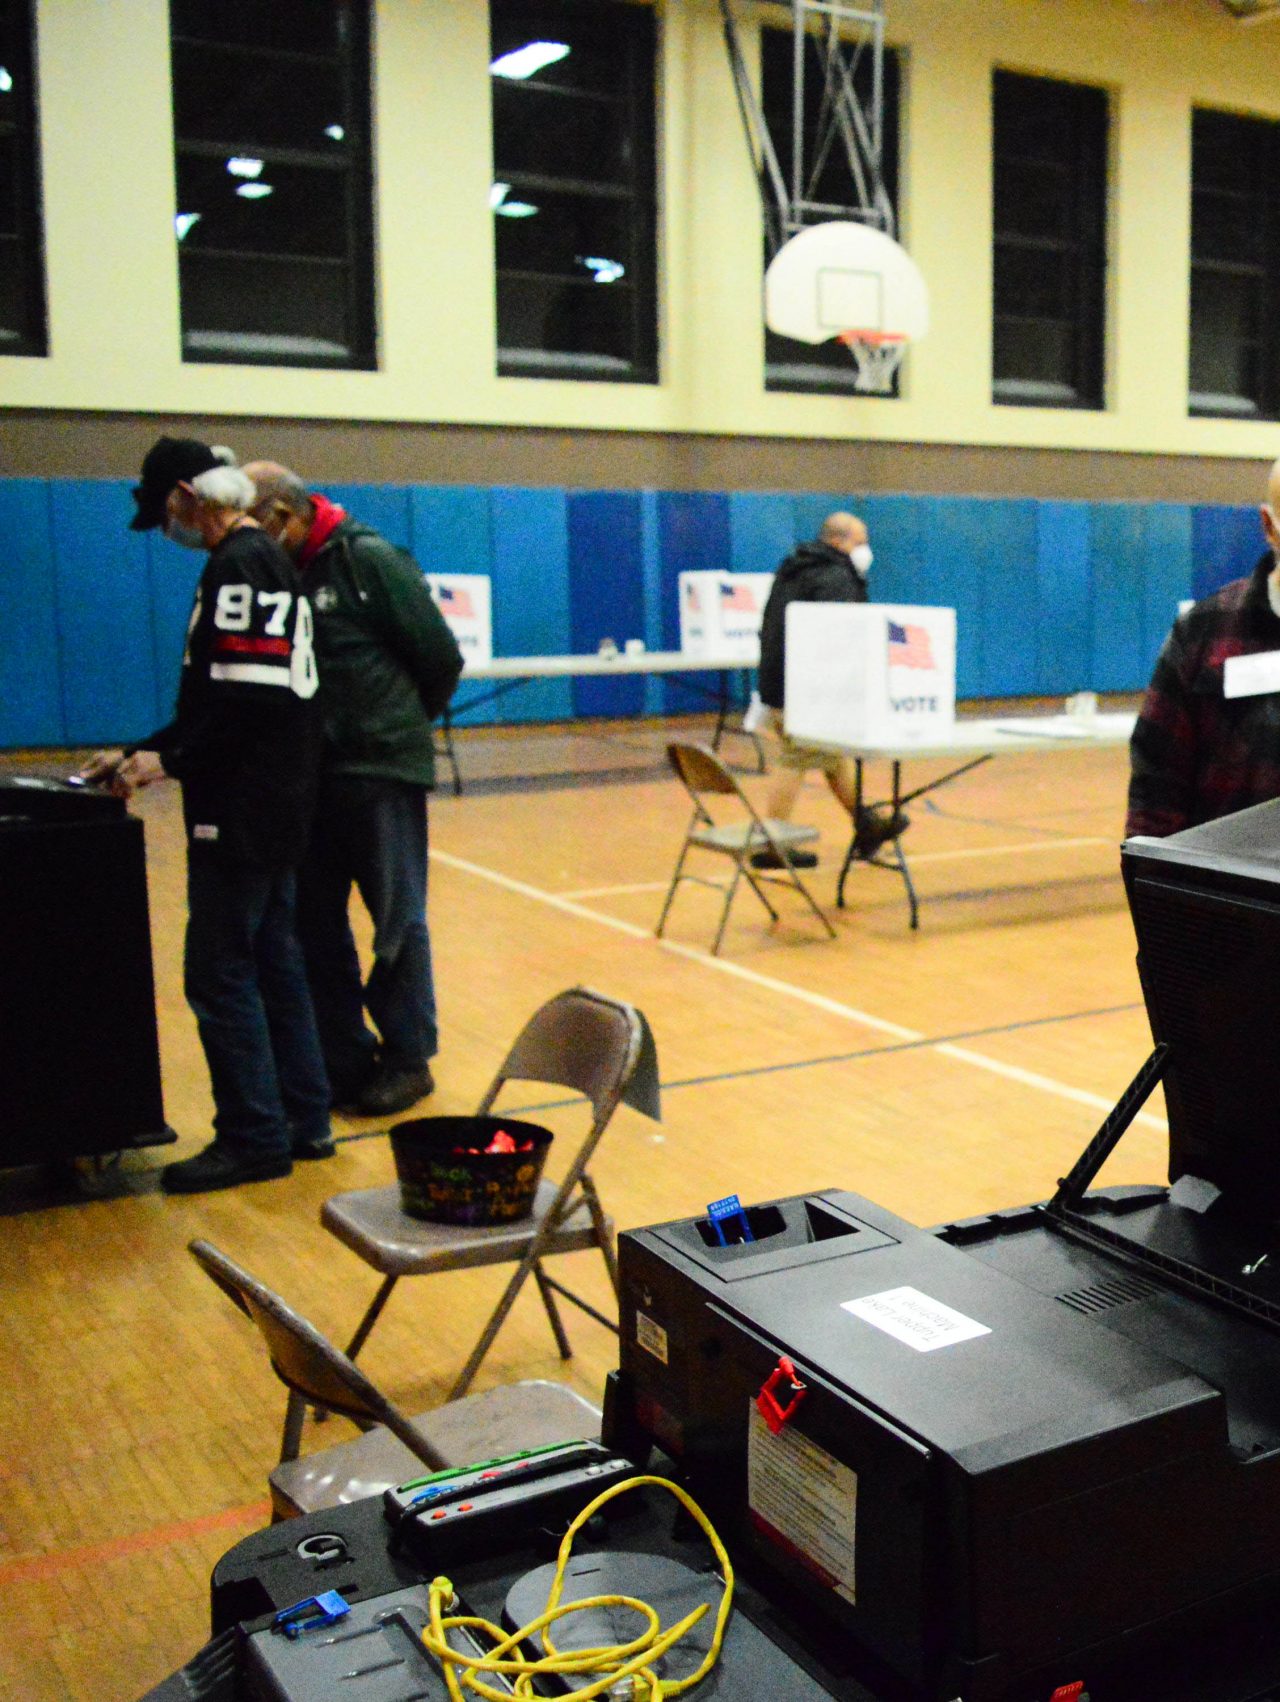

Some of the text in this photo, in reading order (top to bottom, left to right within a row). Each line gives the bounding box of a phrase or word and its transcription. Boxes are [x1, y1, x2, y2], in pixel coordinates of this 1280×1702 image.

[214, 584, 292, 636] 87
[889, 696, 938, 713] VOTE
[860, 1297, 942, 1343] Tupper Lake
[901, 1299, 961, 1332] Machine
